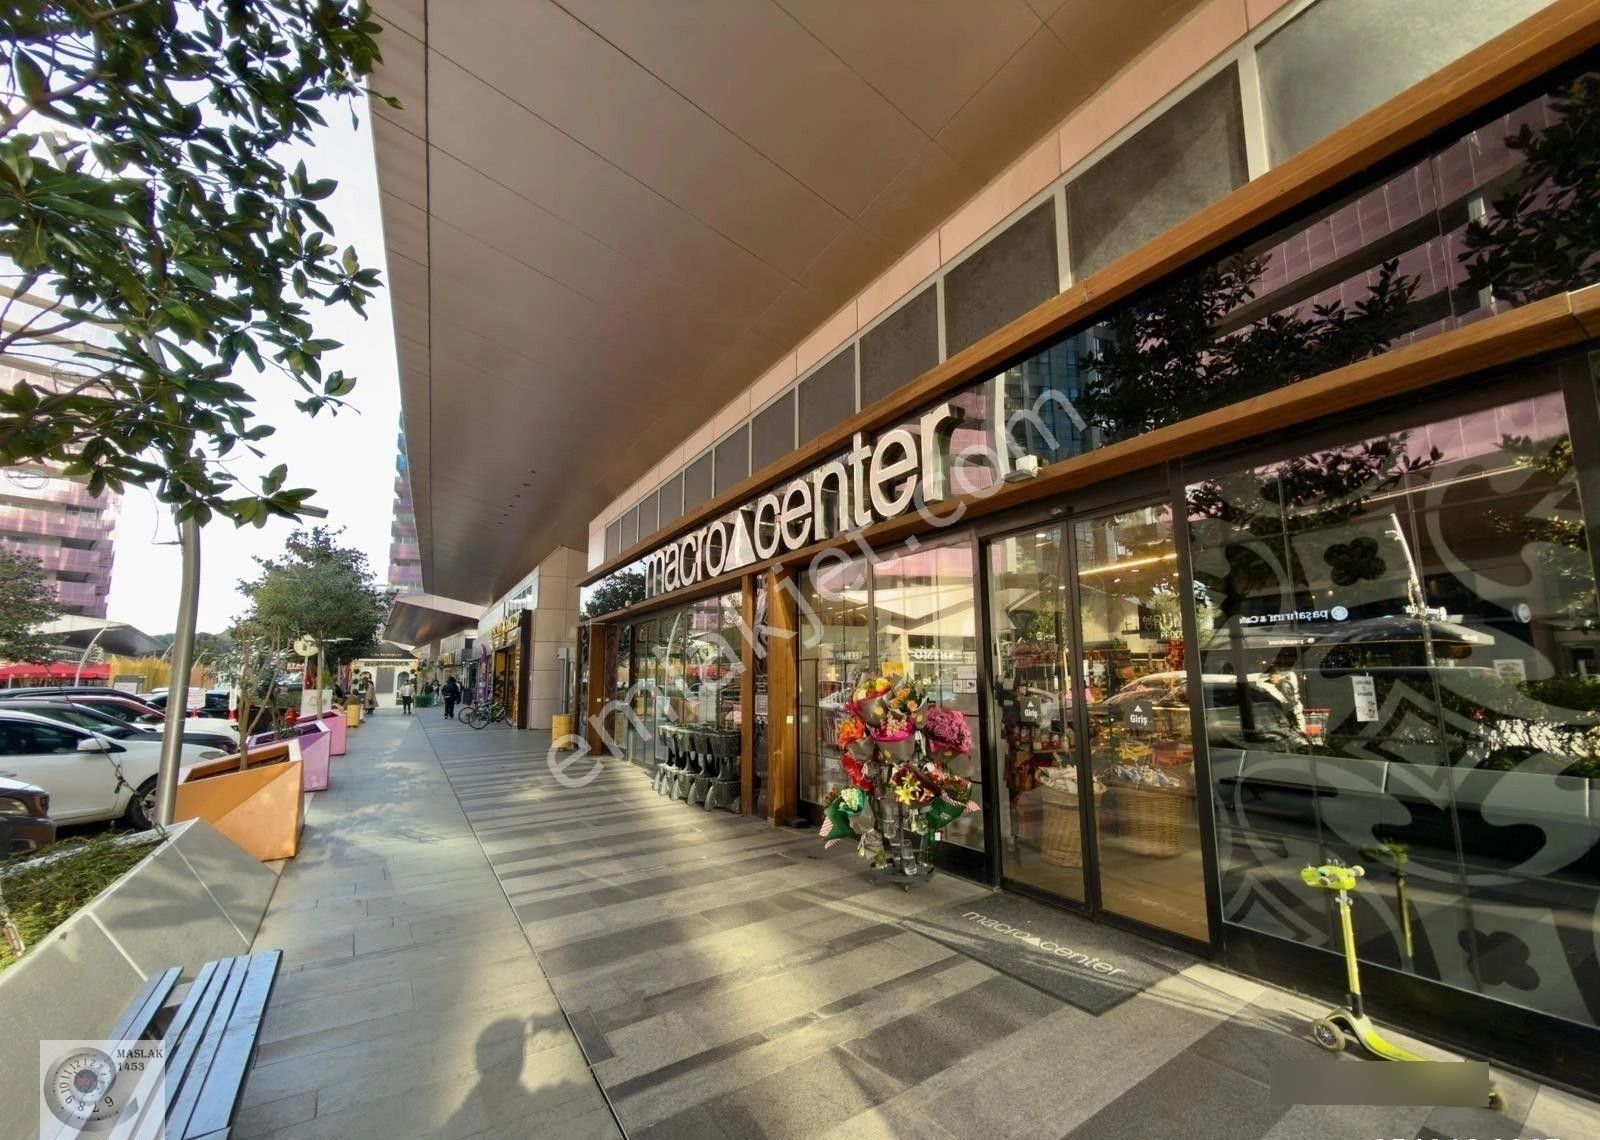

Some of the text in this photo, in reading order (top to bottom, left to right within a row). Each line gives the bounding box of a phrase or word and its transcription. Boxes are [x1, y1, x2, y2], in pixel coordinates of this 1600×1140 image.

[645, 403, 962, 599] macro center
[962, 911, 1127, 976] macro center
